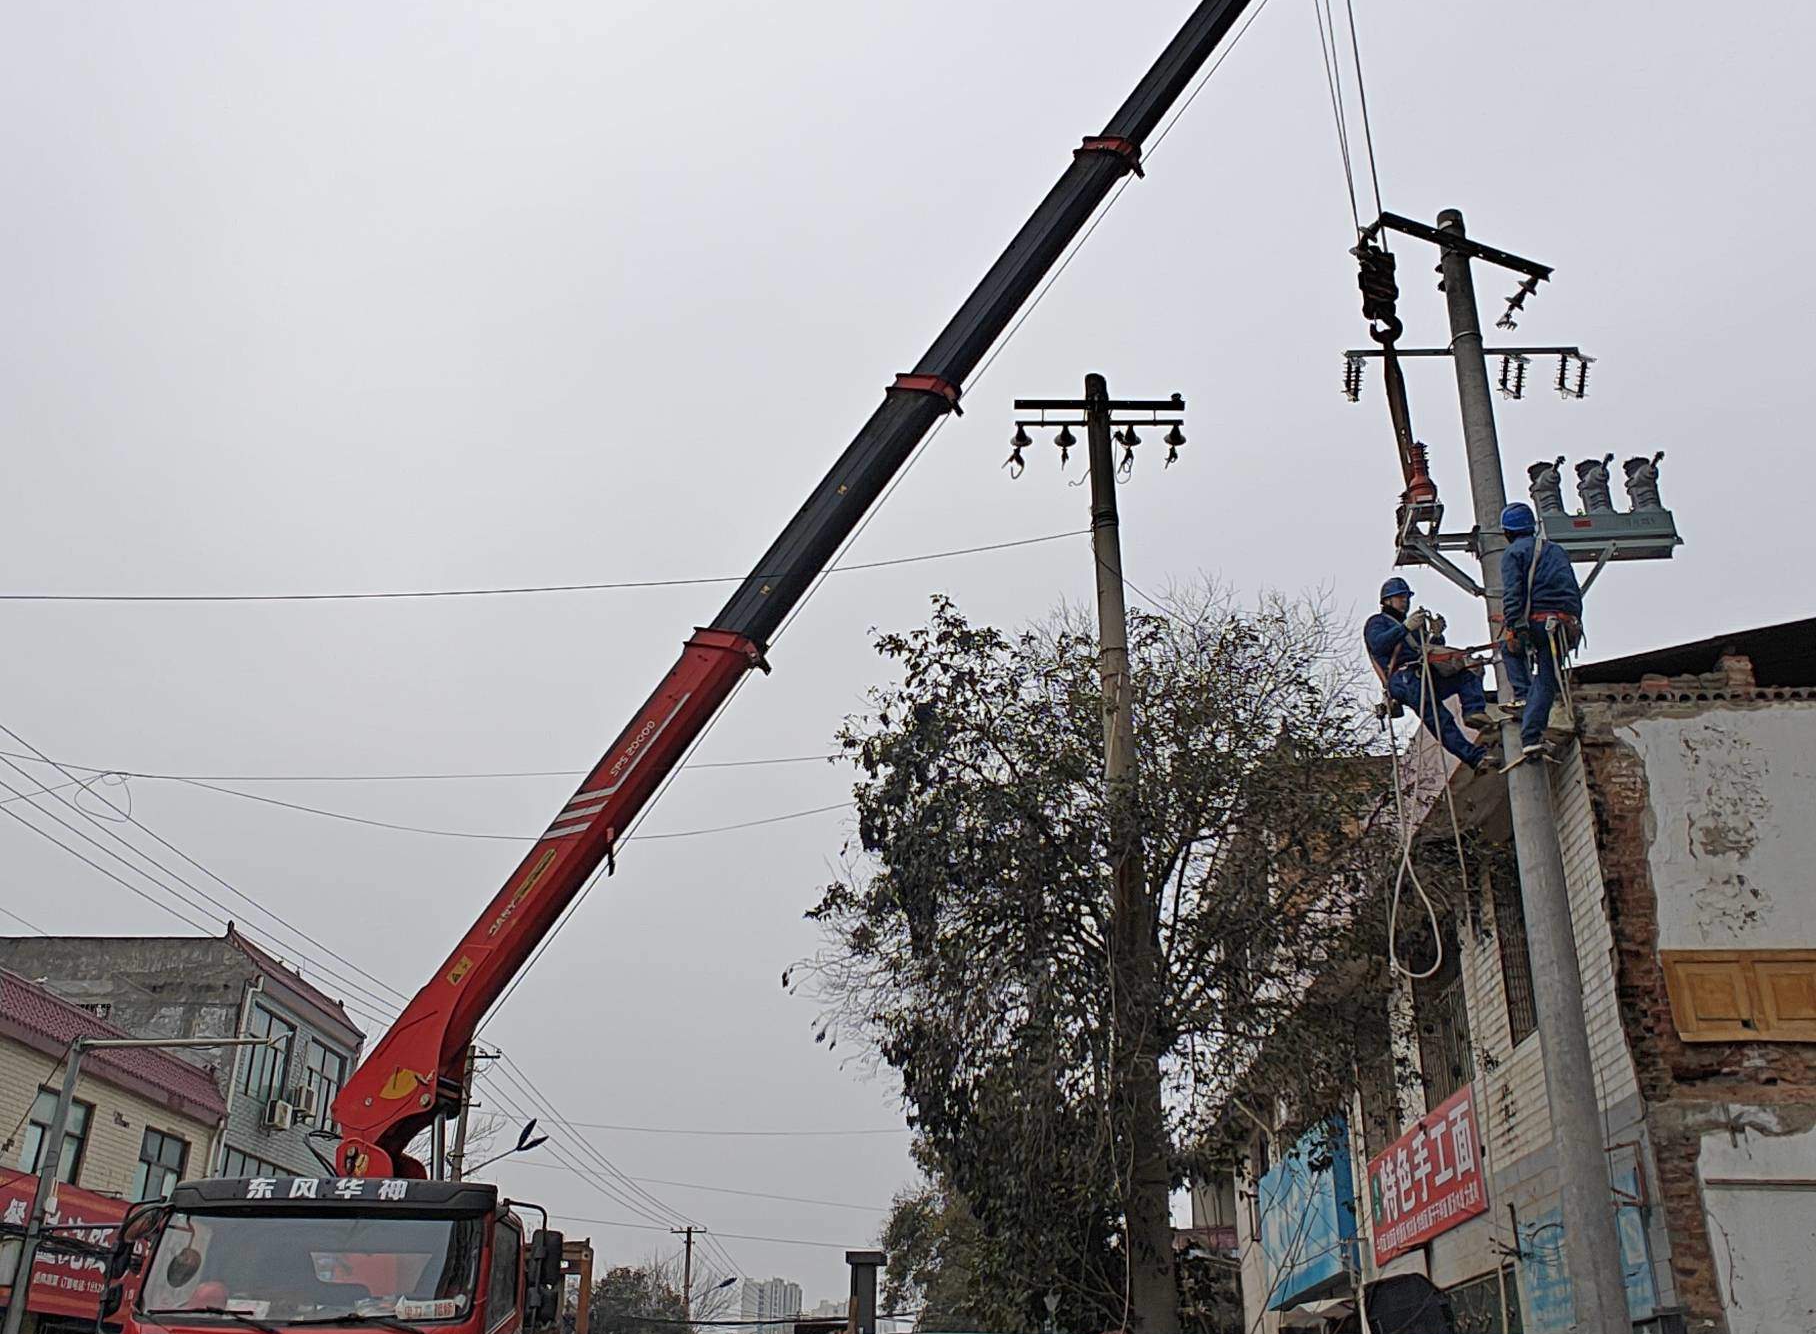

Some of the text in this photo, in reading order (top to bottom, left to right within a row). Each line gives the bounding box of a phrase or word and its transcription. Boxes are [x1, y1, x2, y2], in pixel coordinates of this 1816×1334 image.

[246, 1178, 408, 1201] 东风华神
[1379, 1100, 1475, 1224] 特色手工面
